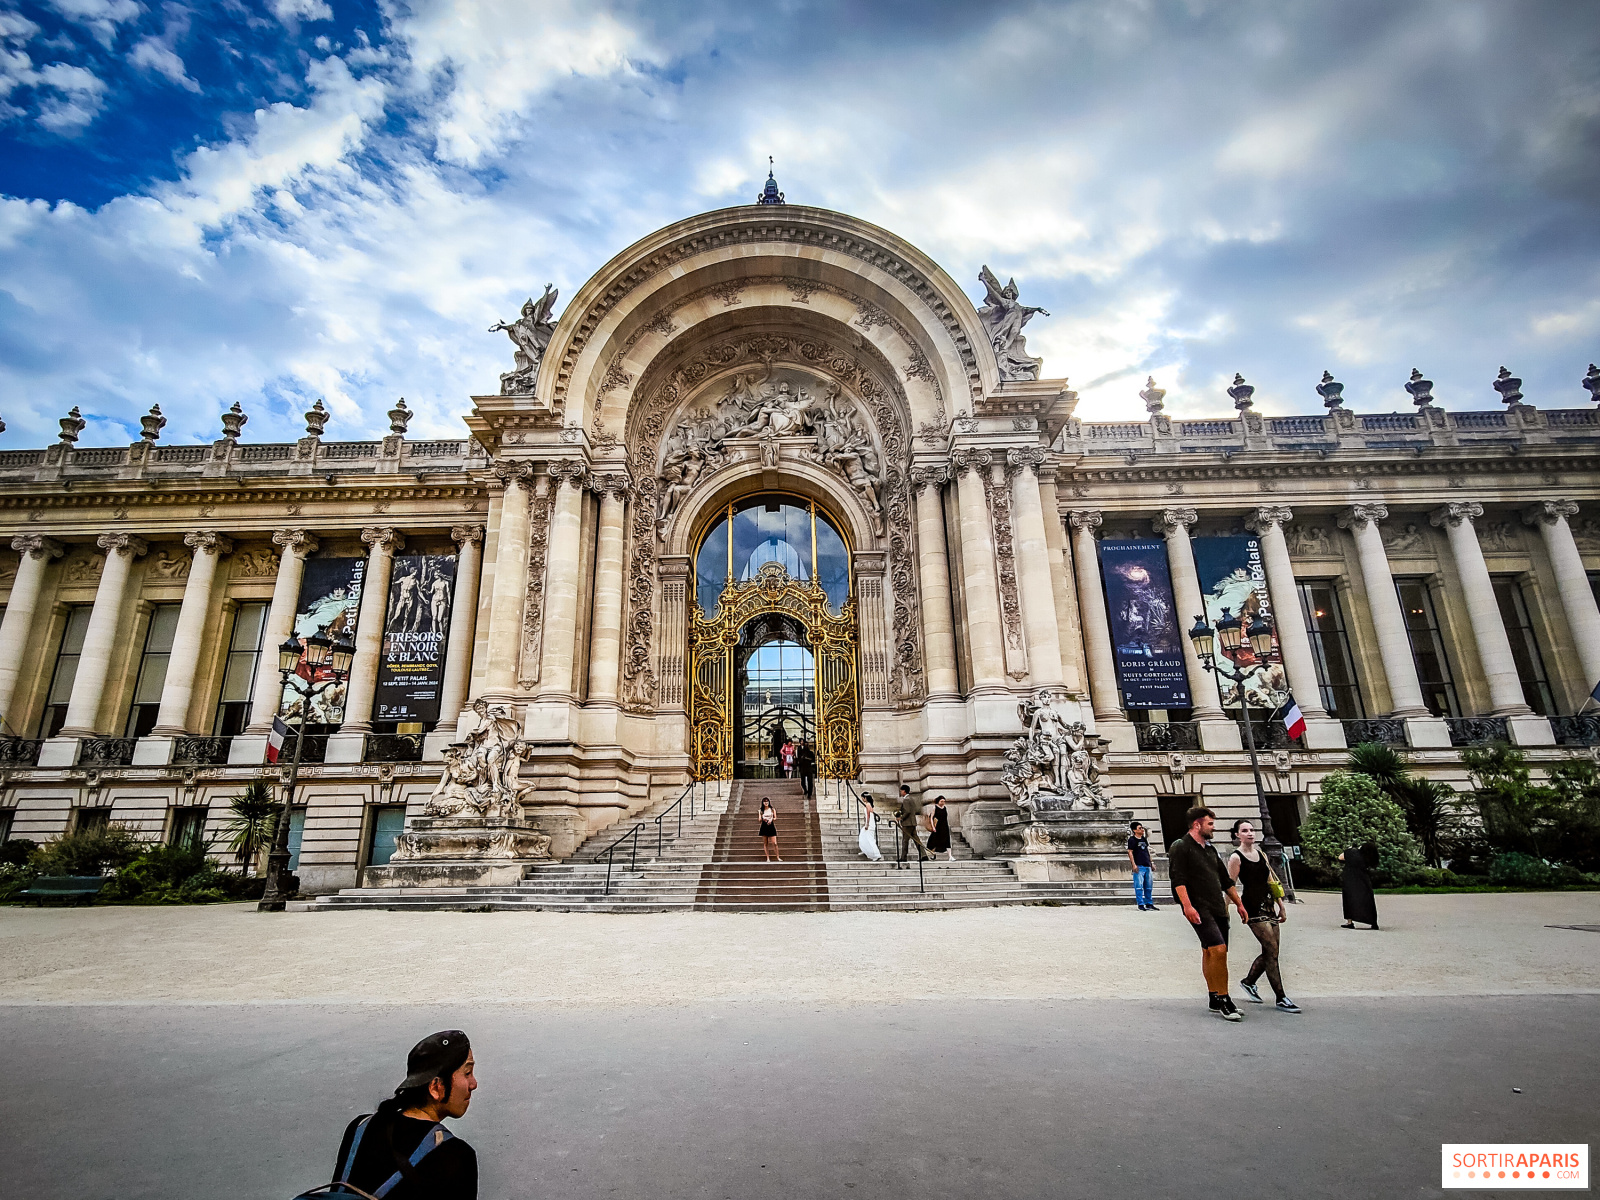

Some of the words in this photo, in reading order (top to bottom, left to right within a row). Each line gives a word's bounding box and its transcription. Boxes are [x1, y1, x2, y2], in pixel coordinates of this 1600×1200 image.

[1246, 540, 1265, 581] Palais
[347, 560, 365, 599] Palais
[342, 599, 358, 634] Petit
[1254, 581, 1271, 617] Petit
[387, 652, 397, 662] &
[399, 652, 438, 662] BLANC
[390, 642, 406, 652] EN
[408, 642, 438, 652] NOIR
